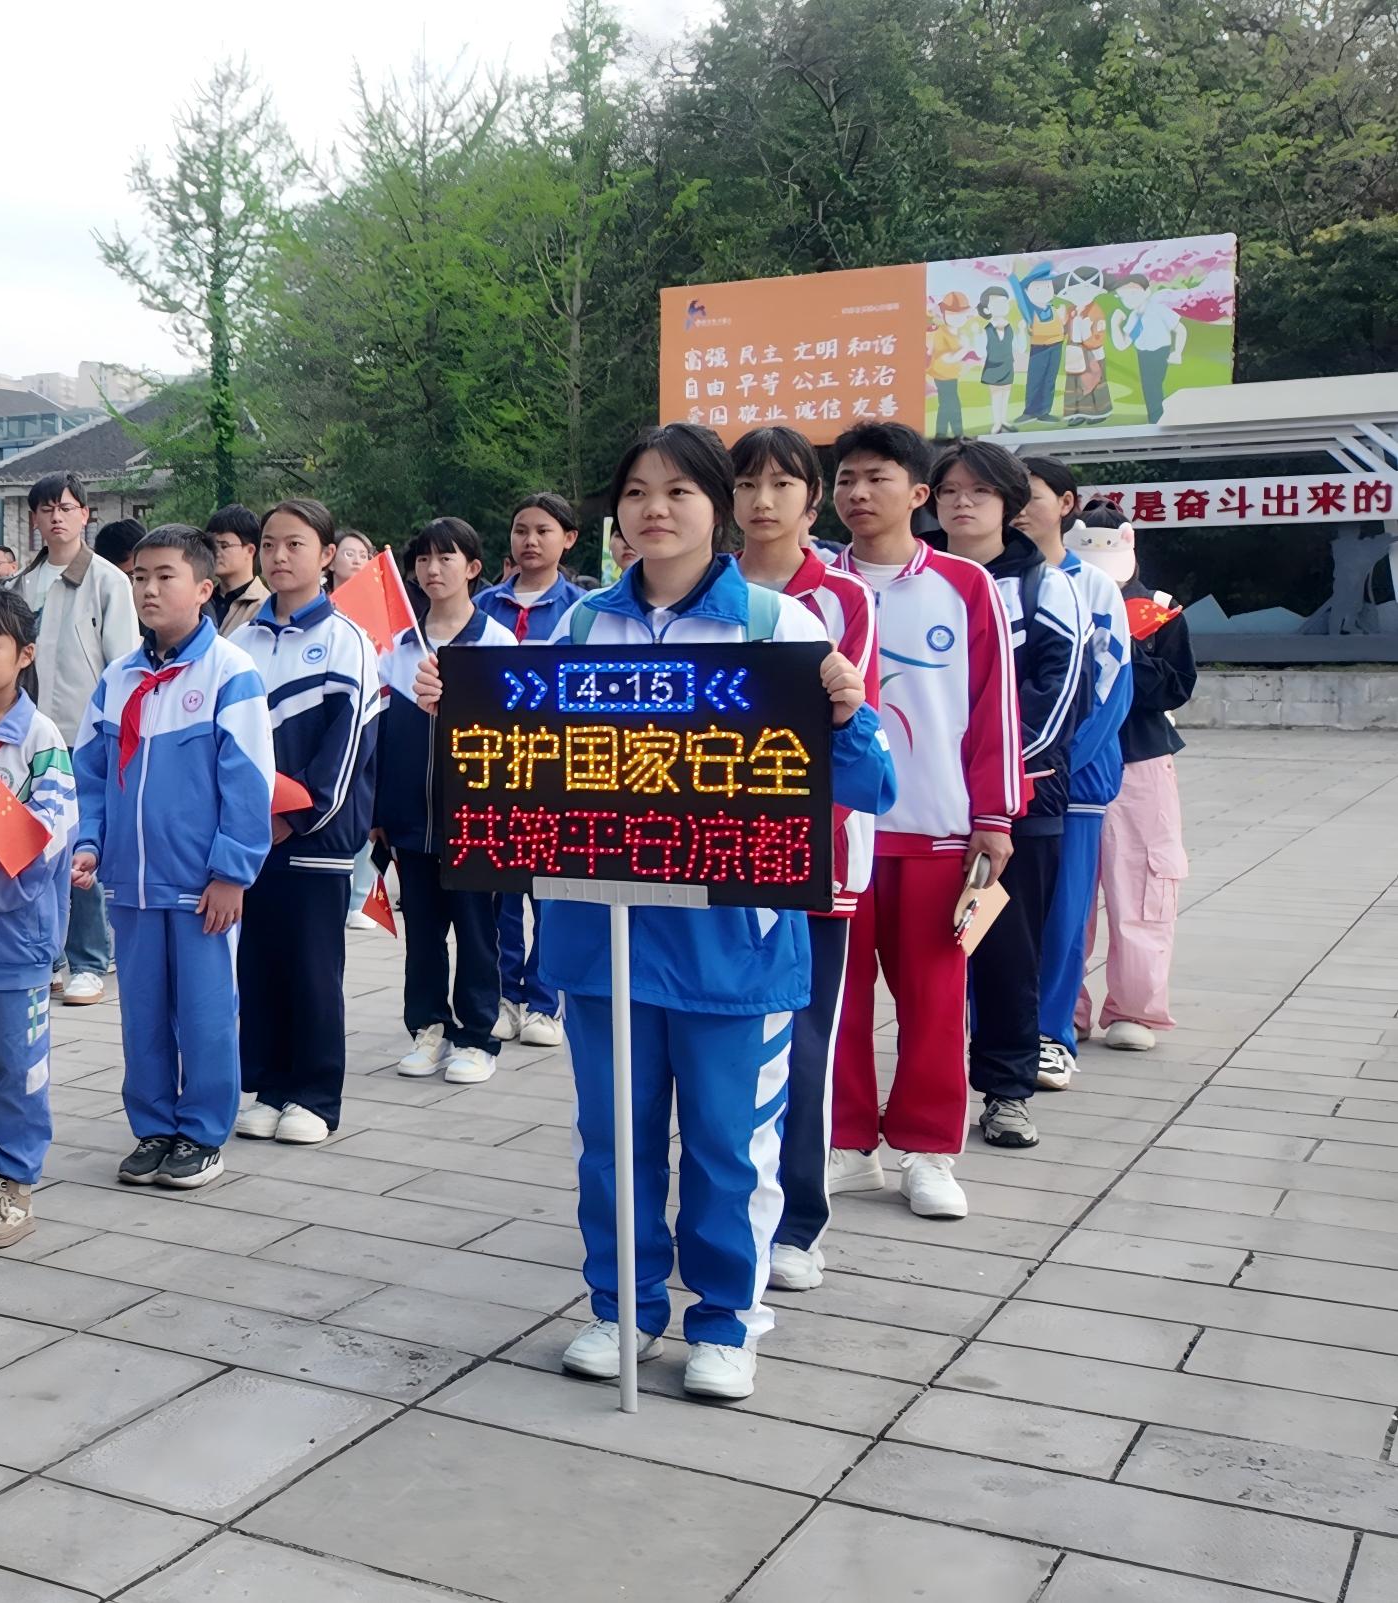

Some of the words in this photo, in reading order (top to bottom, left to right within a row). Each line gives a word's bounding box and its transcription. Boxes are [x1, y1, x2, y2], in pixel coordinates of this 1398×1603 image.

[684, 347, 728, 371] 富强
[739, 344, 783, 366] 民主
[793, 338, 838, 361] 文明
[846, 334, 898, 357] 和谐
[685, 377, 725, 399] 自由
[792, 370, 840, 390] 公正
[847, 365, 896, 386] 法治
[687, 405, 728, 425] 爱国
[738, 404, 788, 424] 敬业
[794, 398, 841, 420] 诚信
[852, 393, 898, 418] 友善
[450, 722, 811, 798] 守护国家安全
[448, 804, 813, 885] 共筑平安凉都
